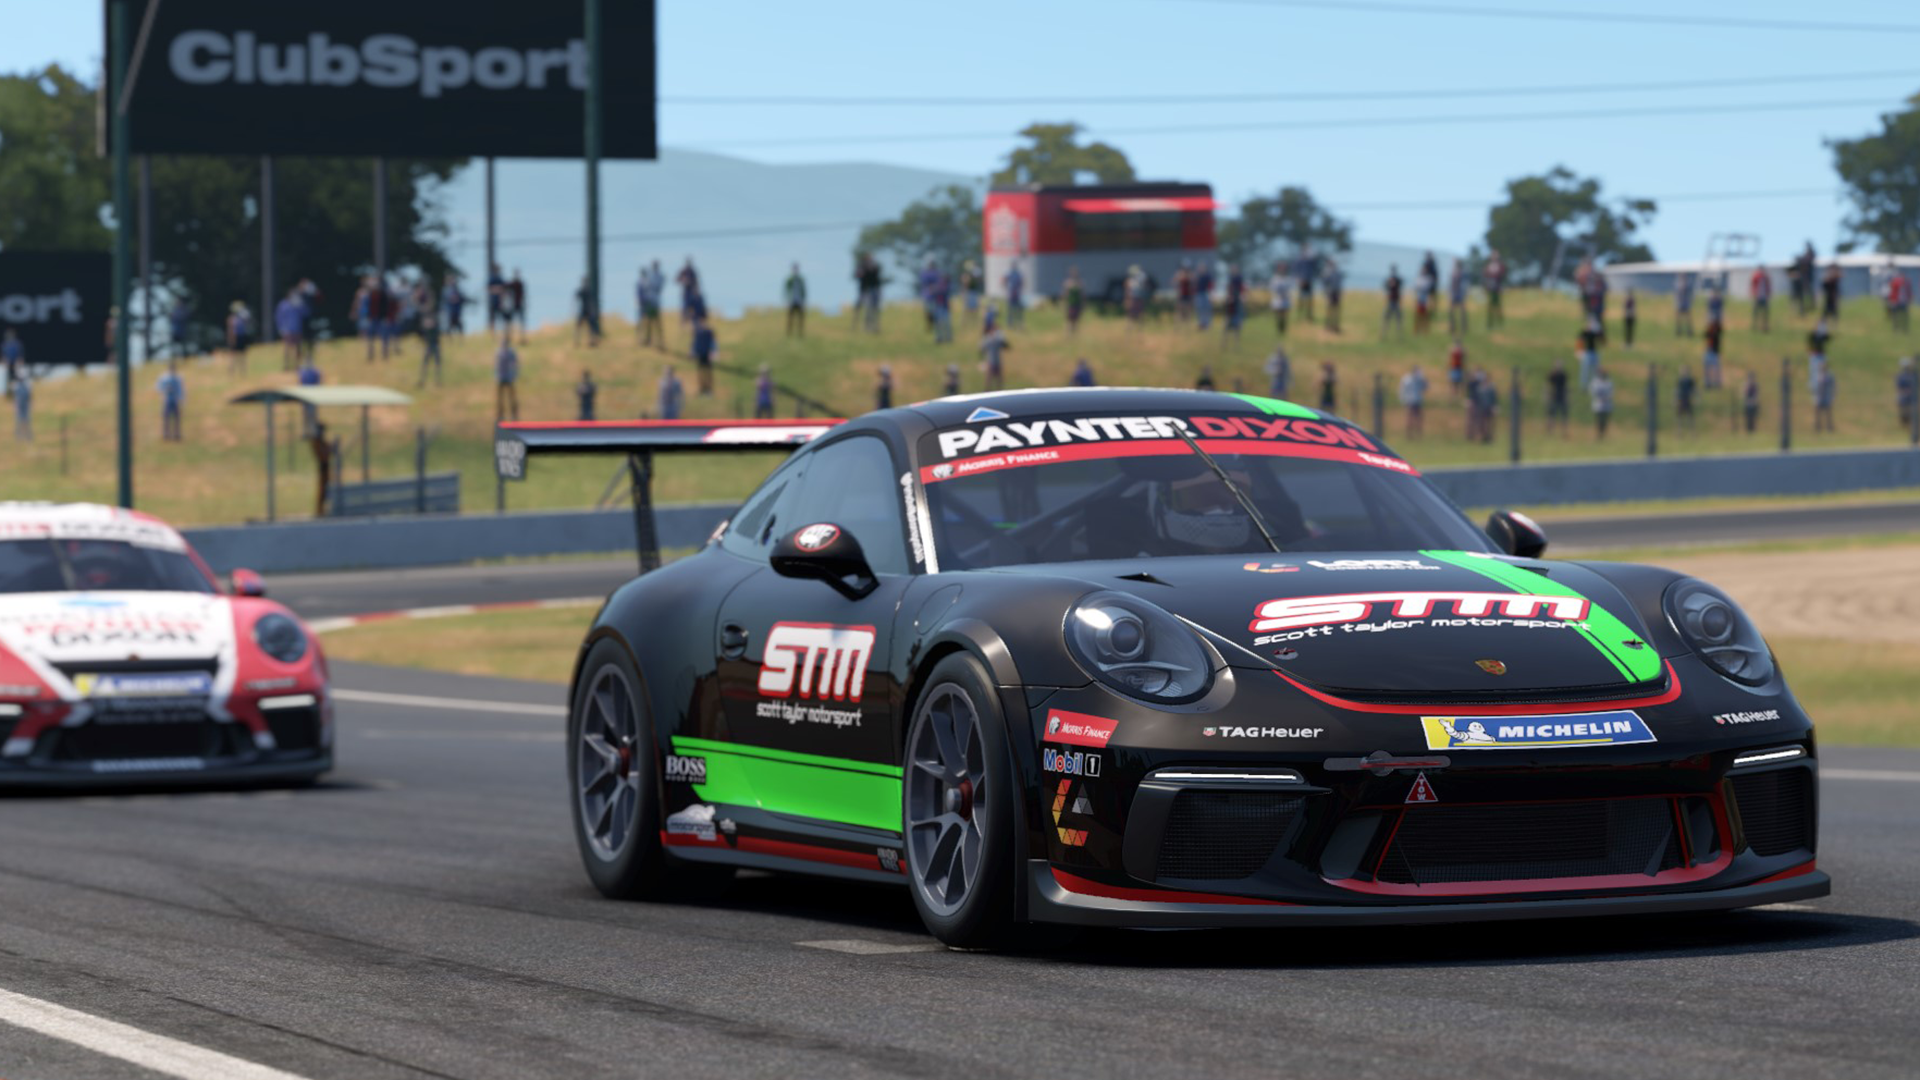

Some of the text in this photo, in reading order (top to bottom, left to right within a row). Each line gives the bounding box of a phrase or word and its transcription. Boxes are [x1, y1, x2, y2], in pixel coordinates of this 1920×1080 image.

[168, 30, 590, 97] ClubSport
[938, 416, 1379, 458] PAYNTER DIXON
[1254, 617, 1592, 646] scott taylor motorsport
[808, 706, 862, 729] motorsport
[1499, 720, 1632, 738] MICHELIN
[666, 755, 706, 777] BOSS
[1044, 748, 1083, 775] Mobil
[1416, 779, 1427, 801] TOW
